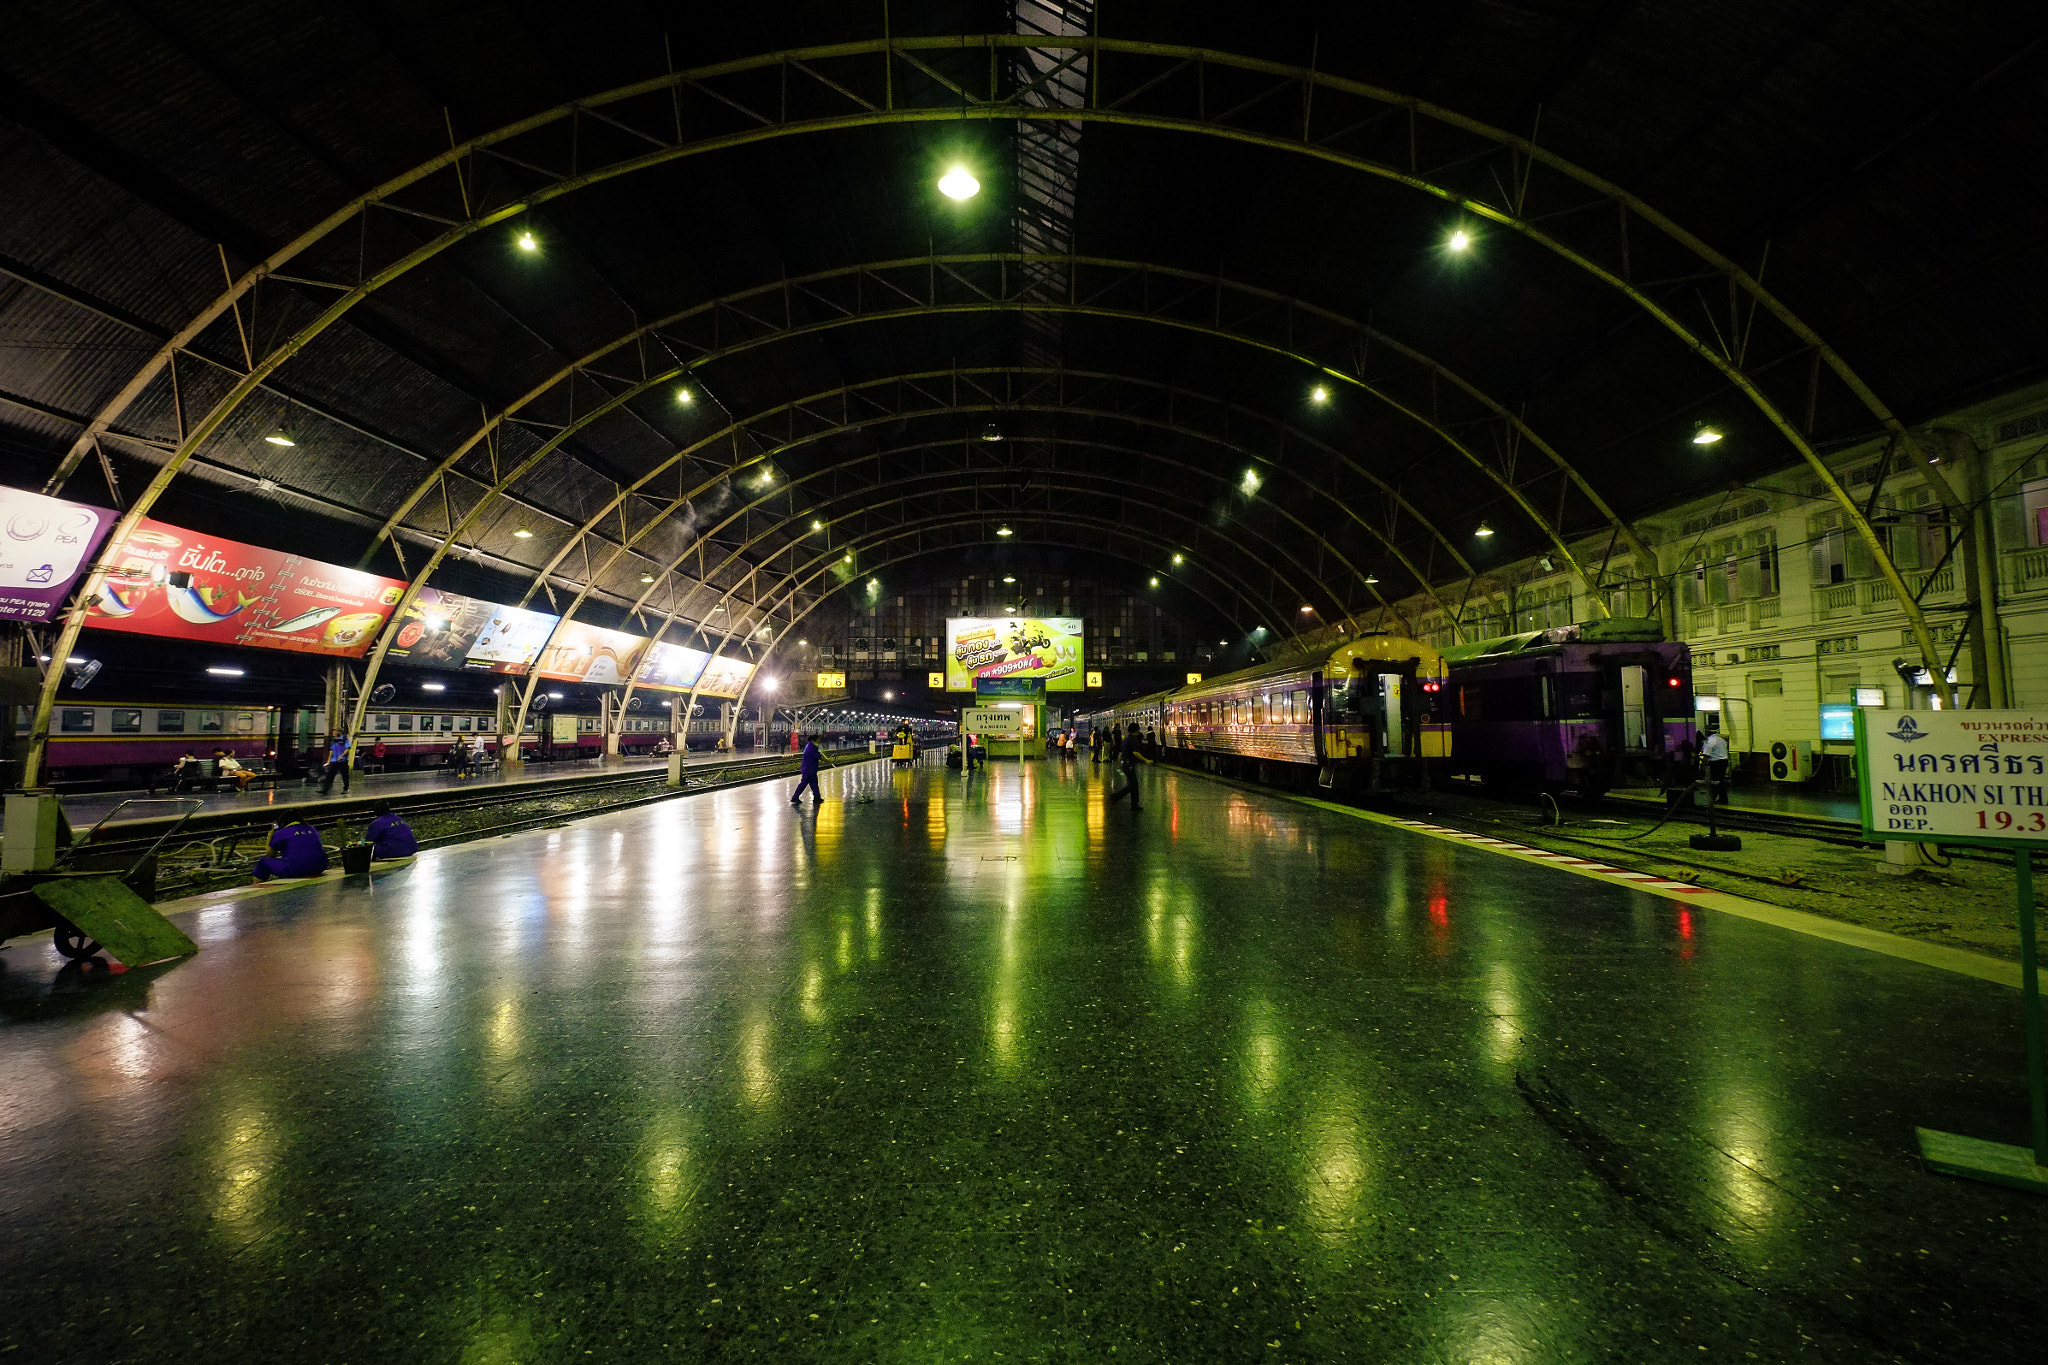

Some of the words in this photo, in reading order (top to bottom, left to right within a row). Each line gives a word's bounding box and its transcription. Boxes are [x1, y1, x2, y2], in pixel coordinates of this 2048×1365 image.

[55, 535, 78, 543] PEA
[21, 608, 46, 617] 1129
[976, 714, 1011, 724] กรุงเทพ
[1882, 782, 1976, 804] NAKHON
[1983, 784, 2003, 805] SI
[1889, 804, 1927, 816] ออก
[1888, 818, 1934, 831] DEP.
[1975, 810, 2047, 832] 19.3
